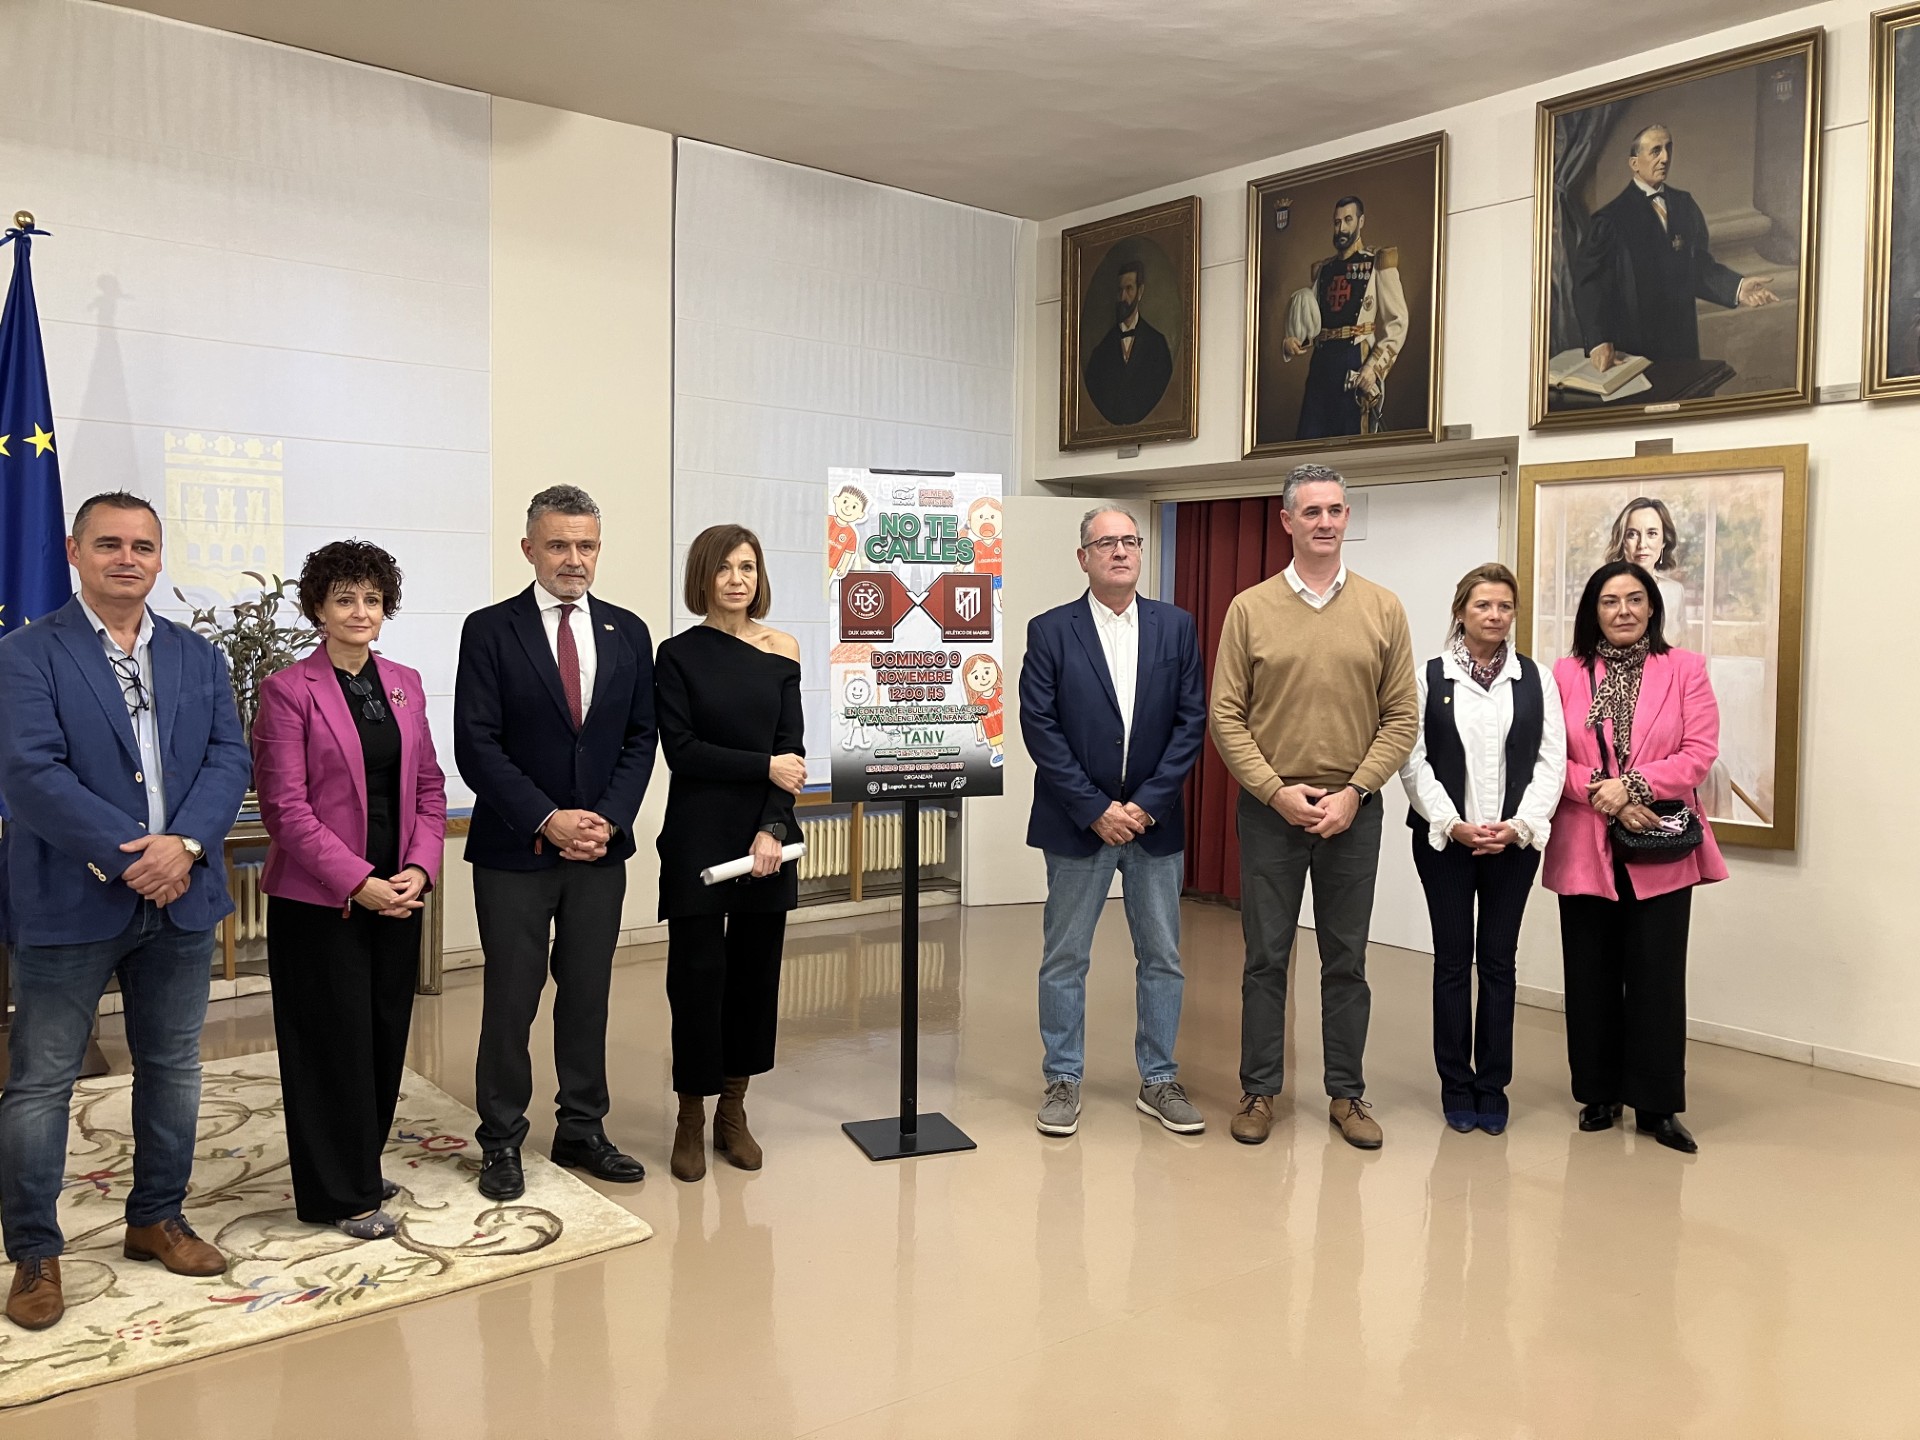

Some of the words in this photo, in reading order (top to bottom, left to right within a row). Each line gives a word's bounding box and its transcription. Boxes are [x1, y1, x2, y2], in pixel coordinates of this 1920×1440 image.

[880, 513, 920, 539] NO
[924, 514, 958, 539] TE
[865, 534, 975, 564] CALLES
[872, 652, 946, 667] DOMINGO
[949, 651, 960, 667] 9
[877, 670, 952, 684] NOVIEMBRE
[889, 687, 925, 701] 12:00
[926, 687, 945, 700] HS
[846, 708, 856, 716] EN
[858, 706, 890, 715] CONTRA
[902, 730, 945, 744] TANV
